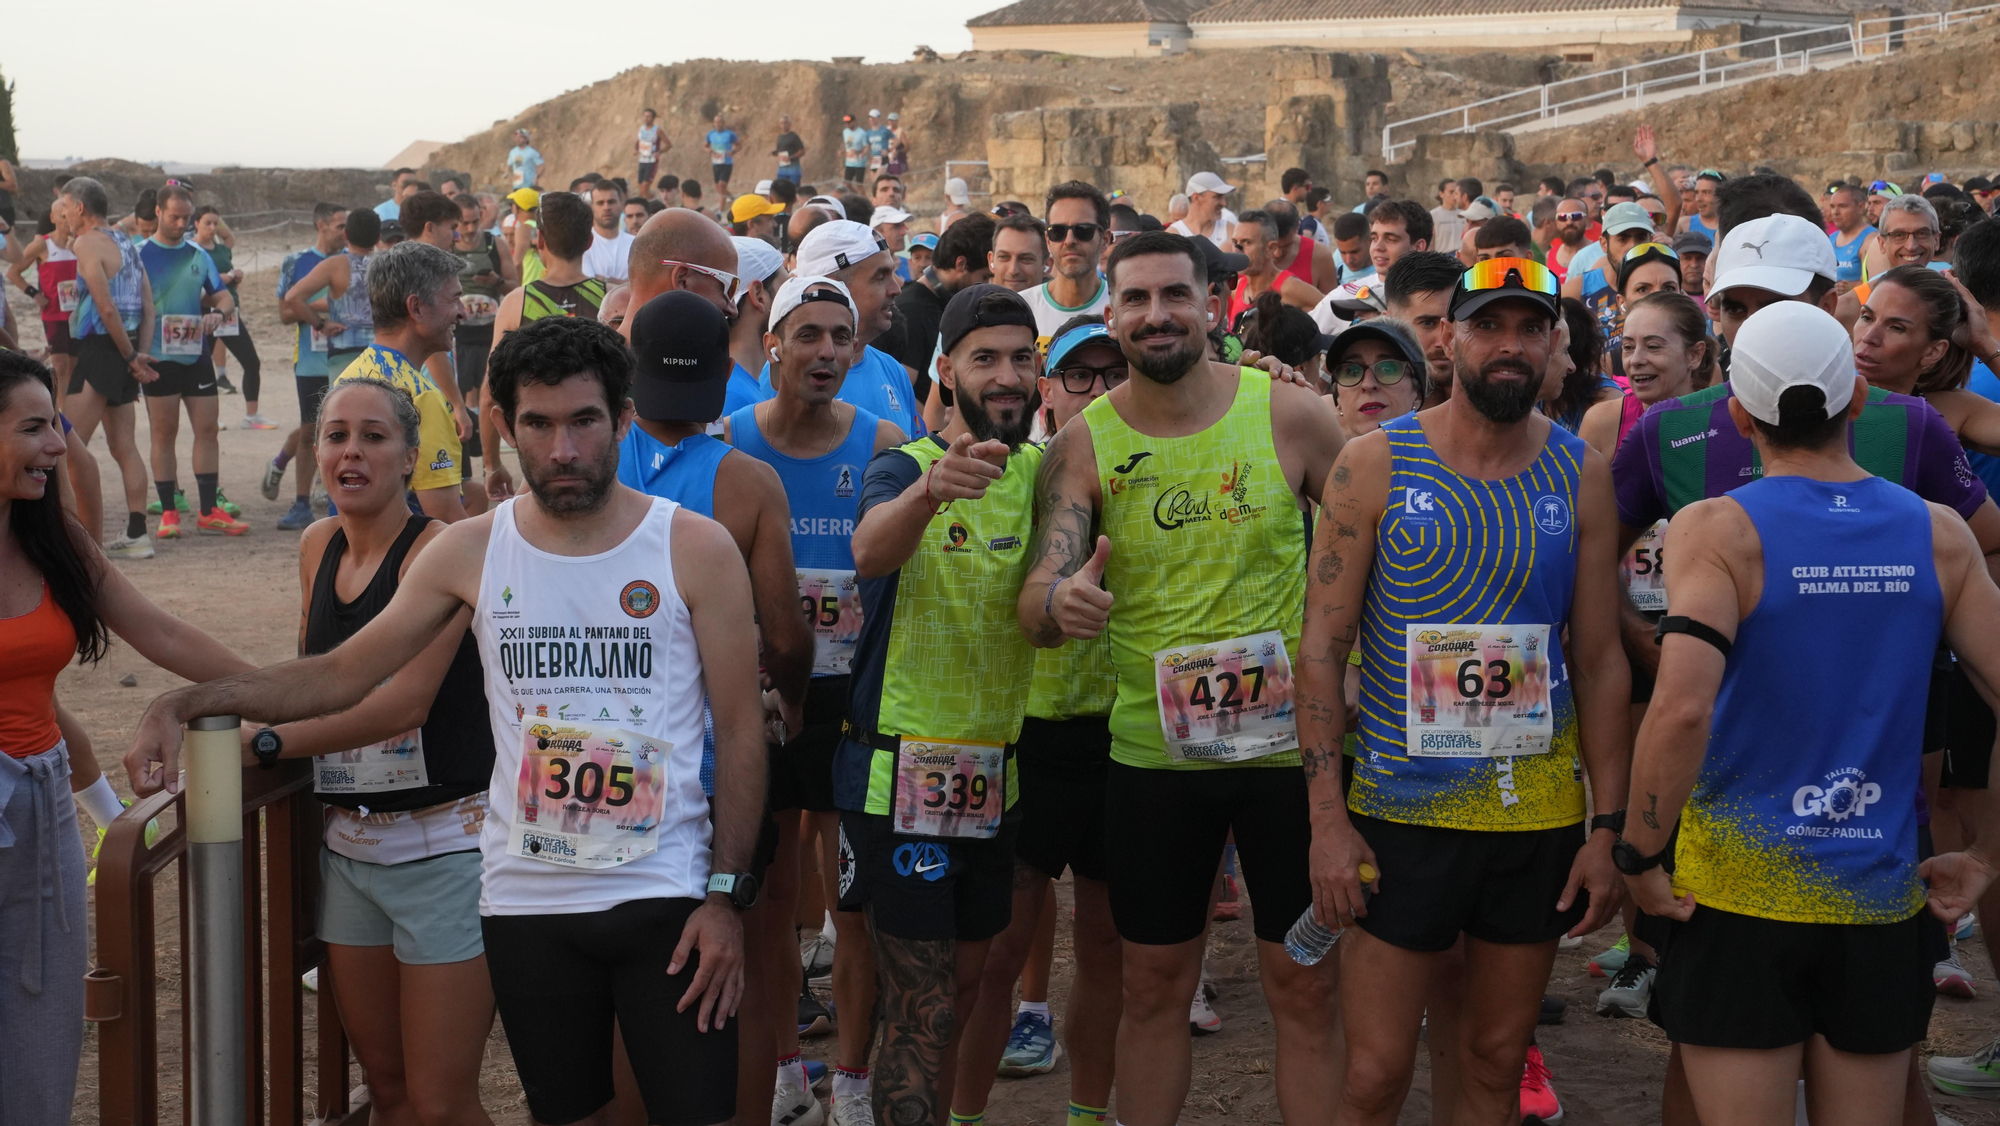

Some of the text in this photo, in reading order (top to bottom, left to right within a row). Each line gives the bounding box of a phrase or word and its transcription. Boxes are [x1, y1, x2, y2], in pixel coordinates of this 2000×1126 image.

[663, 357, 698, 366] KIPRUN
[1671, 431, 1705, 449] luanvi
[1128, 476, 1159, 485] Diputación
[1136, 482, 1159, 490] Córdoba
[1167, 490, 1211, 520] Rad
[1185, 515, 1212, 523] METAL
[790, 517, 854, 536] ASIERR
[1792, 565, 1915, 578] CLUB ATLETISMO
[1799, 579, 1910, 594] PALMA DEL RÍO
[801, 595, 839, 626] 95
[500, 627, 651, 640] XXII SUBIDA AL PANTANO DEL
[1416, 630, 1442, 645] 40
[500, 642, 652, 684] QUIEBRAJANO
[1162, 653, 1184, 667] 40
[1457, 659, 1512, 699] 63
[521, 688, 533, 696] QUE
[536, 687, 552, 695] UNA
[554, 686, 593, 694] CARRERA,
[595, 686, 613, 694] UNA
[614, 686, 652, 695] TRADICIÓN
[1190, 665, 1264, 711] 427
[1261, 710, 1292, 720] serizona
[529, 724, 552, 740] 40
[1421, 733, 1472, 742] carreras
[903, 743, 928, 756] 40
[1181, 742, 1227, 753] carreras
[1183, 746, 1236, 757] populares
[1421, 739, 1482, 750] populares
[1824, 767, 1867, 781] TALLERES
[545, 758, 634, 807] 305
[924, 772, 987, 810] 339
[592, 807, 610, 815] SORIA
[1786, 823, 1883, 839] GÓMEZ-PADILLA
[523, 833, 568, 848] carreras
